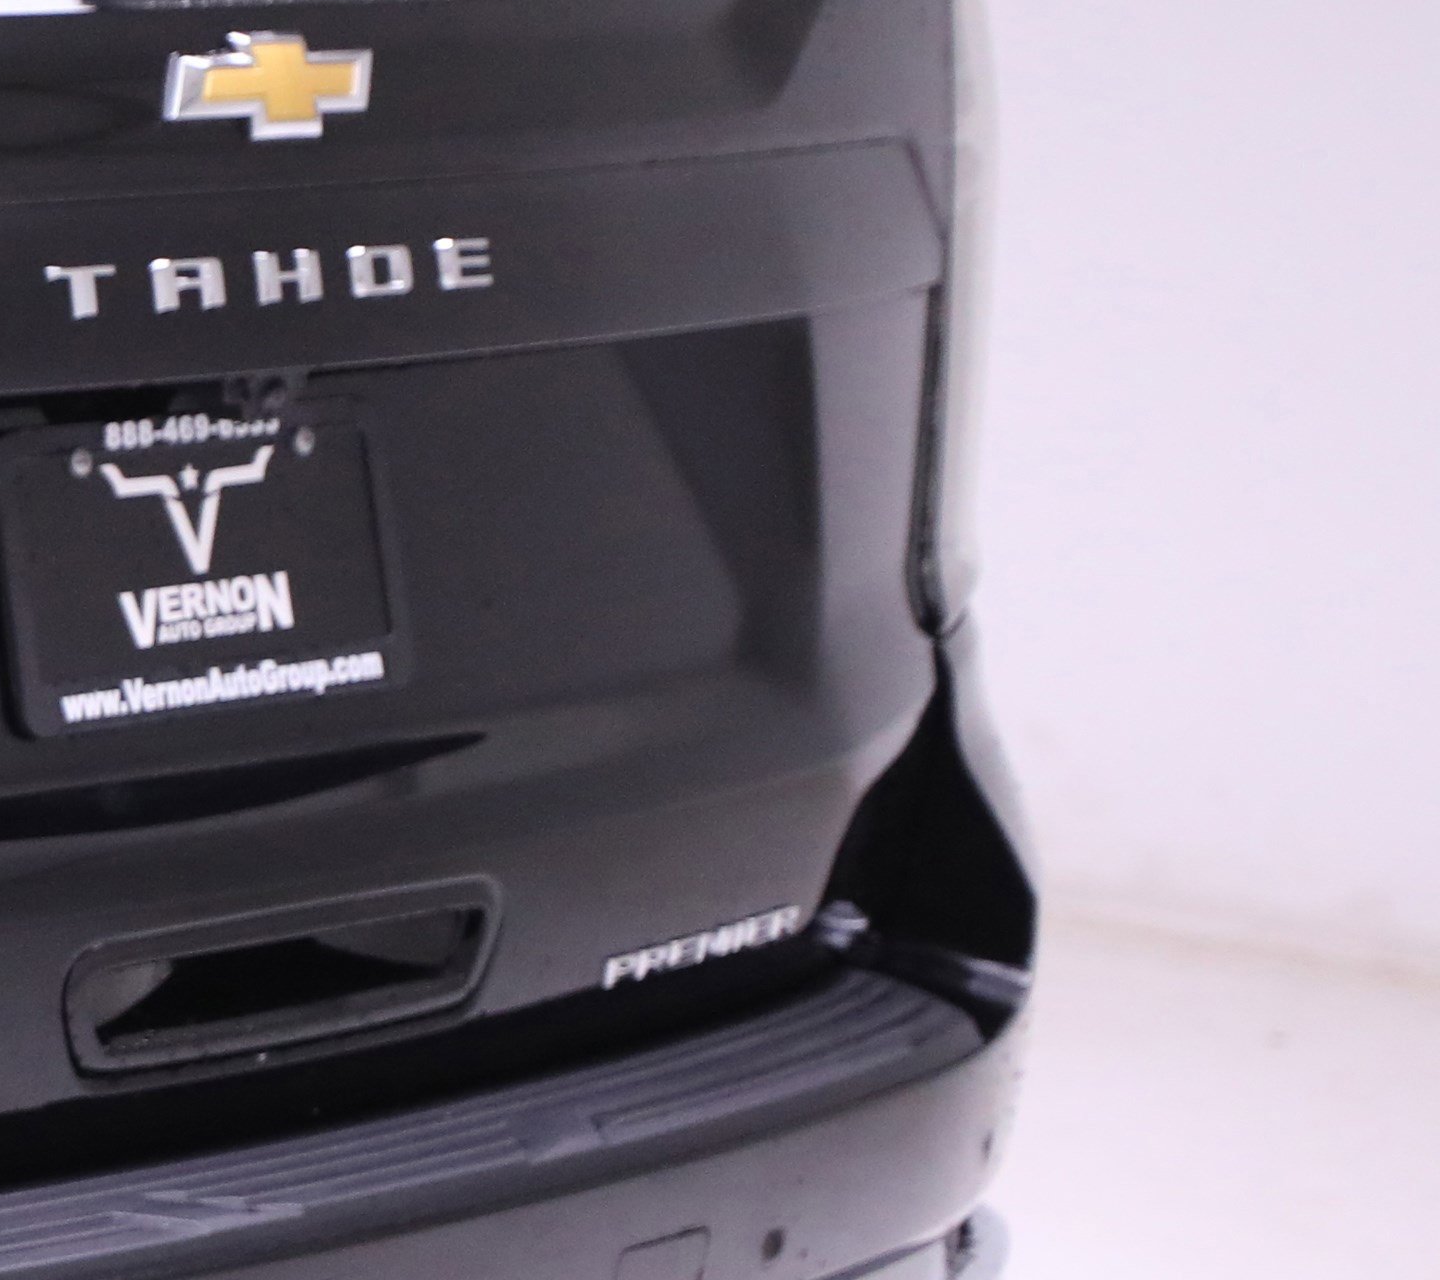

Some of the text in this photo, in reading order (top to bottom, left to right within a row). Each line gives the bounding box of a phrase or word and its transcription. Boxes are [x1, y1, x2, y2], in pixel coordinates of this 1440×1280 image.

[45, 236, 495, 320] TAHOE
[118, 570, 295, 650] VERNON
[157, 611, 257, 645] AUTO GROUP
[59, 650, 385, 723] www.VernonAutoGroup.com
[602, 904, 801, 991] PREMIER
